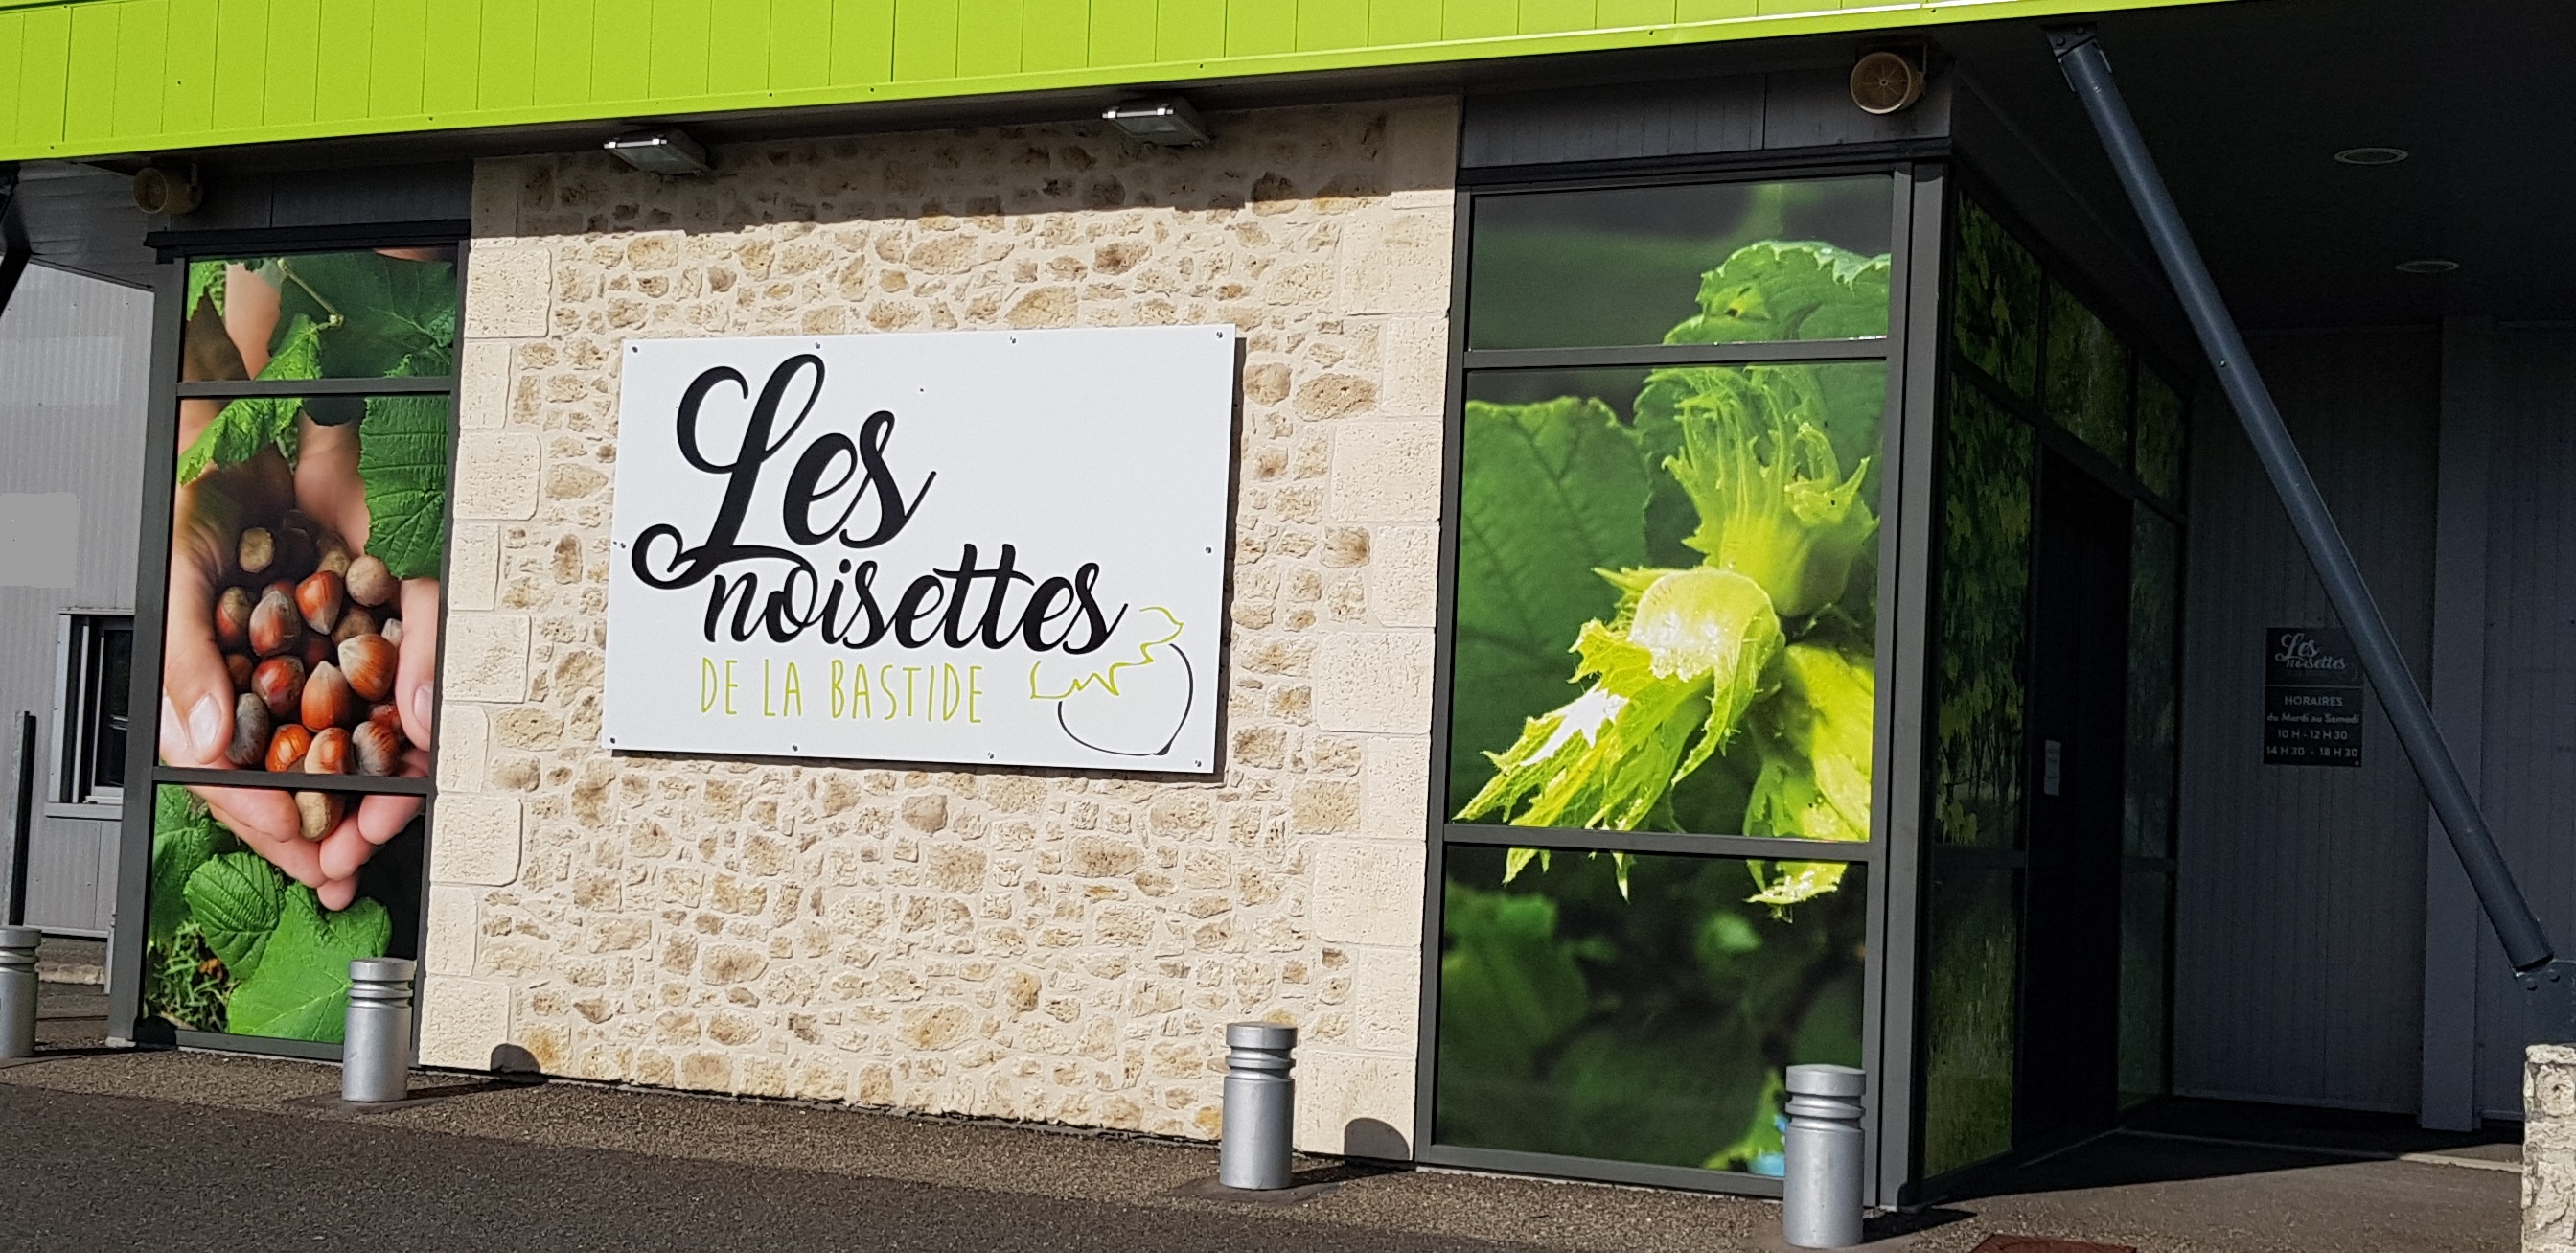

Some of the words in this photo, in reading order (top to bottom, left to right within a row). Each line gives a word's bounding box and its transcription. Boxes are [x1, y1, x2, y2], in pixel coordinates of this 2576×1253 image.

[632, 354, 936, 589] Les
[702, 543, 1128, 655] noisettes
[2274, 632, 2319, 661] Les
[2285, 654, 2347, 670] noisettes
[701, 658, 737, 715] DE
[763, 661, 802, 718] LA
[830, 660, 983, 724] BASTIDE
[2284, 695, 2343, 707] HORAIRES
[2266, 712, 2279, 722] du
[2281, 711, 2310, 723] Mardi
[2324, 713, 2359, 724] Samedi
[2278, 729, 2288, 739] 10
[2291, 729, 2300, 739] H
[2310, 730, 2321, 740] 12
[2323, 730, 2332, 740] H
[2334, 730, 2348, 741] 30
[2266, 745, 2277, 755] 14
[2280, 746, 2289, 755] H
[2291, 746, 2306, 756] 30
[2334, 747, 2342, 757] H
